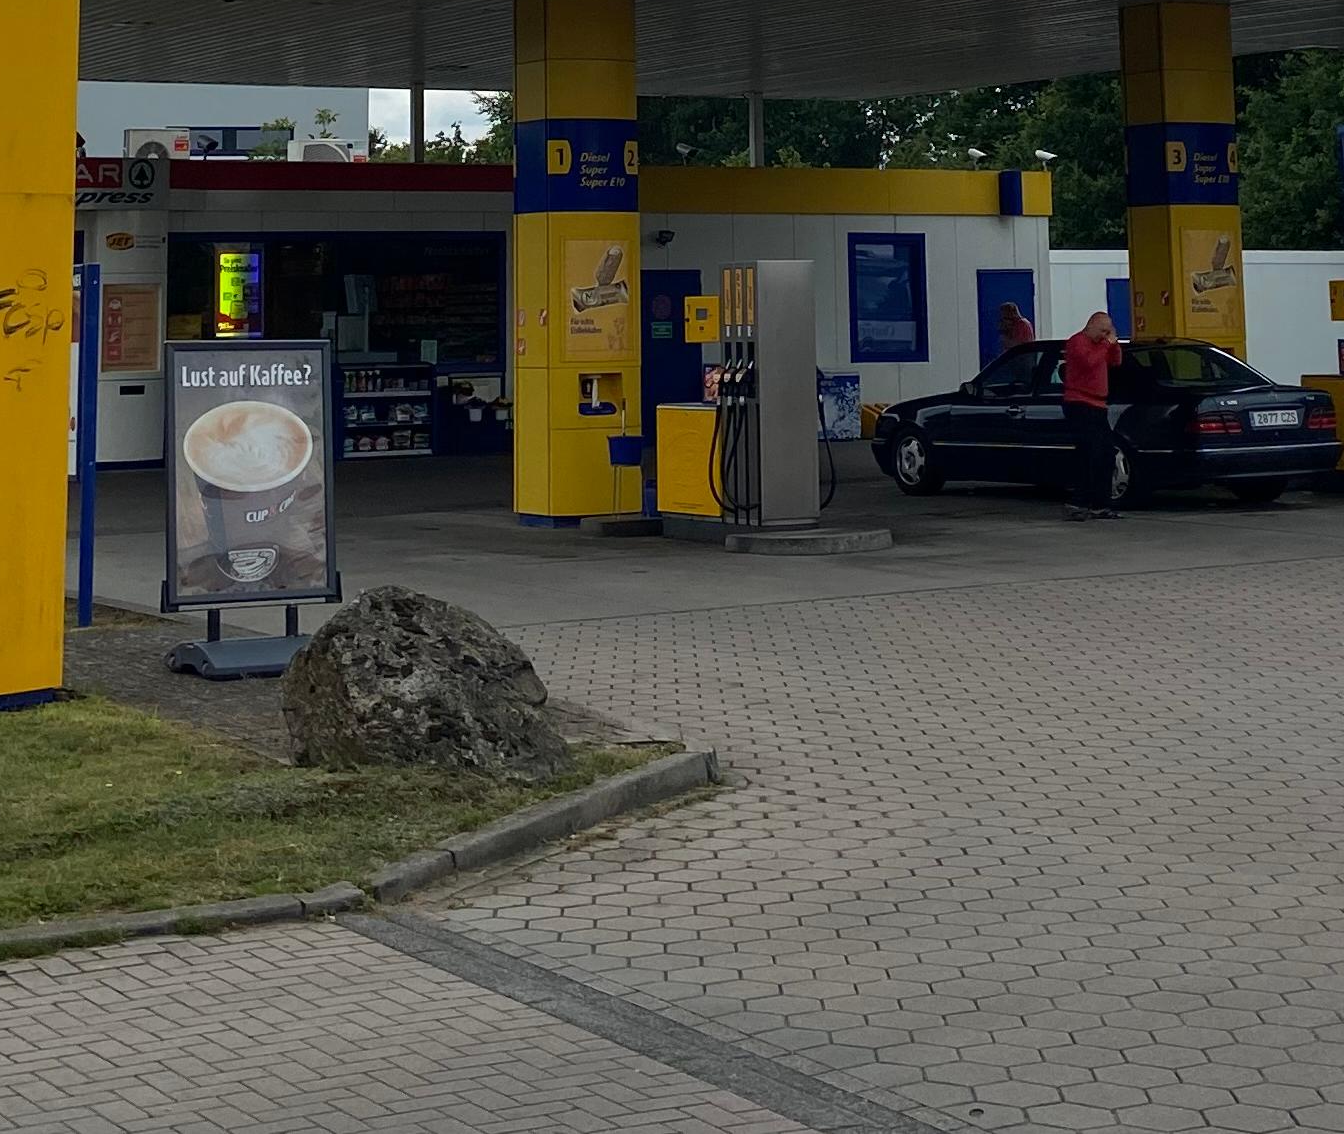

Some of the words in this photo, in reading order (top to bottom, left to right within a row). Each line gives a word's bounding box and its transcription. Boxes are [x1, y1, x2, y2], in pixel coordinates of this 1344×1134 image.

[556, 149, 564, 165] 1
[580, 152, 609, 163] Diesel
[627, 149, 635, 166] 2
[1172, 149, 1182, 165] 3
[1229, 150, 1237, 166] 4
[76, 163, 121, 183] AR
[580, 165, 608, 175] Super
[580, 177, 609, 188] Super
[609, 177, 626, 187] E10
[75, 192, 154, 206] press
[181, 366, 216, 387] Lust
[219, 364, 246, 387] auf
[250, 363, 312, 387] Kaffee?
[1257, 413, 1279, 425] 2877
[246, 509, 269, 523] CUP
